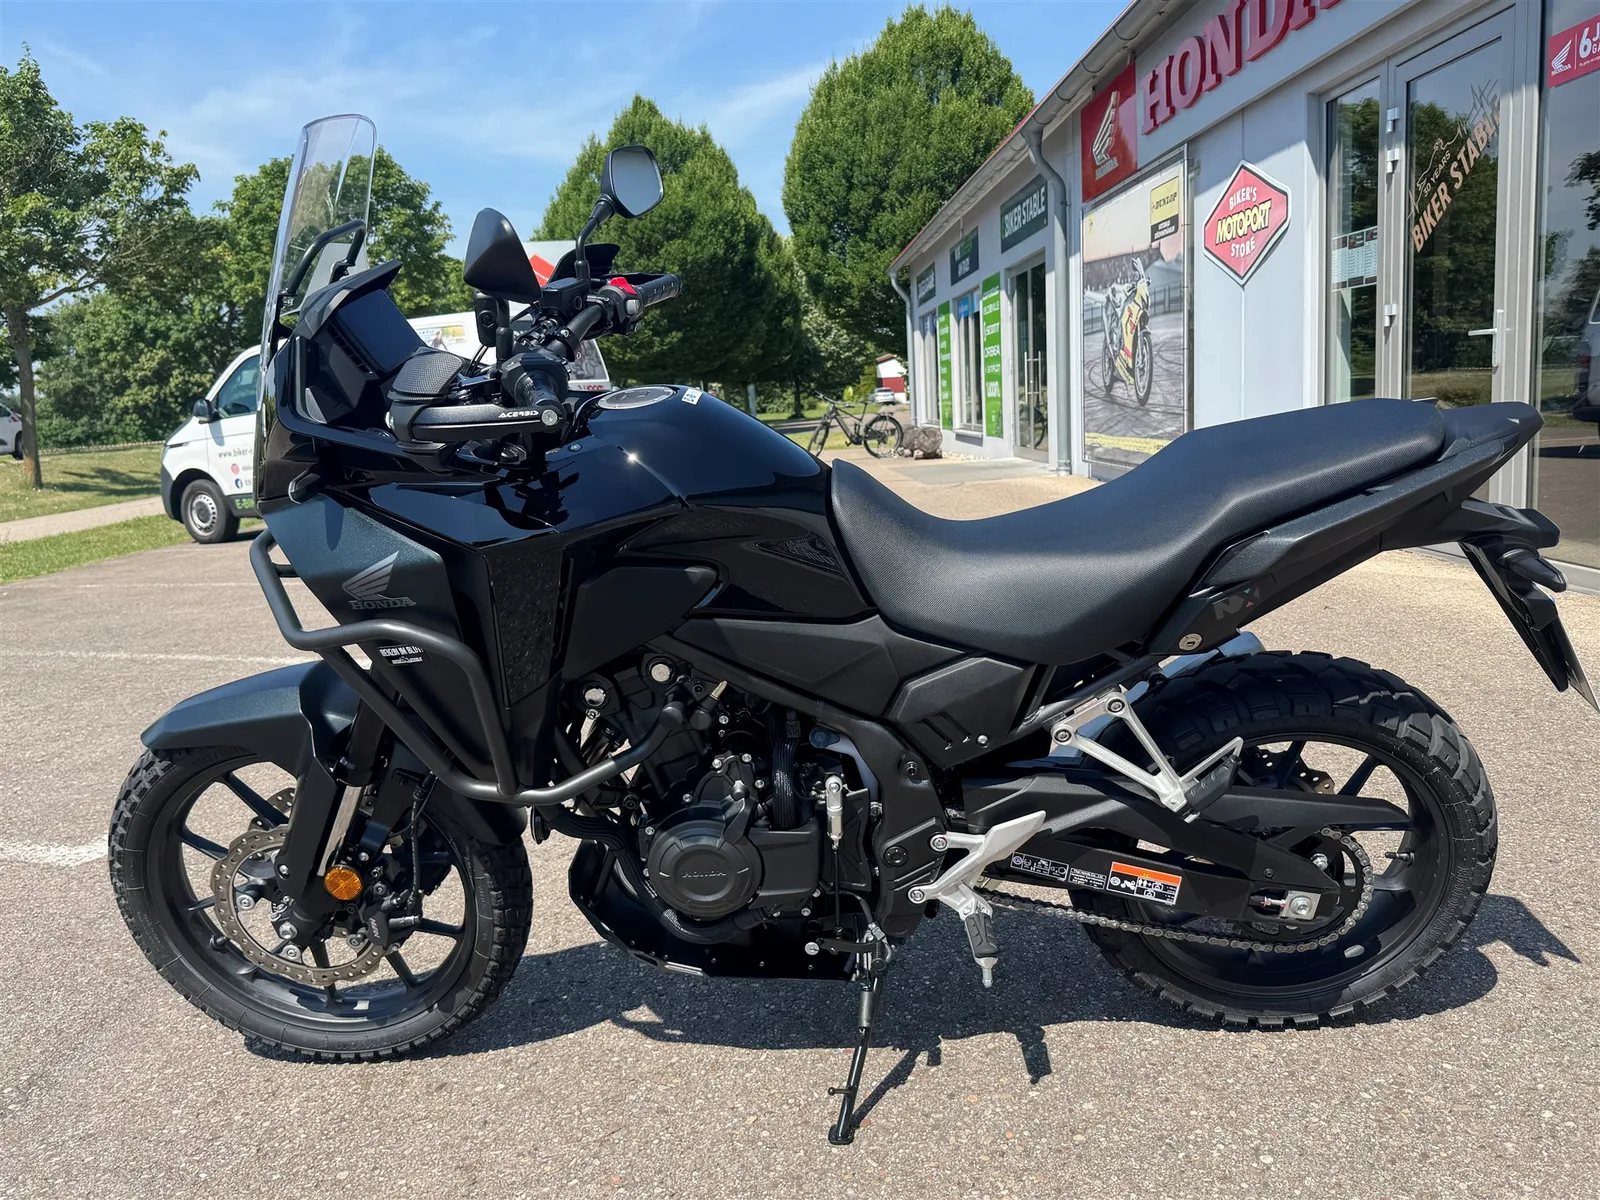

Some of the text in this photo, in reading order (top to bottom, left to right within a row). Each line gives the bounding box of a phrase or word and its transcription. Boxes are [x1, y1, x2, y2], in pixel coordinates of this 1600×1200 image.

[1579, 26, 1592, 59] 6
[1140, 0, 1340, 135] HOND
[1430, 150, 1451, 184] YEARS
[1005, 186, 1046, 238] BIKER STABLE
[1155, 192, 1178, 210] DUNLOP
[1229, 186, 1257, 211] BIKER'S
[1215, 198, 1272, 246] MOTOPORT
[1411, 182, 1452, 253] BIKER
[1230, 235, 1256, 258] STORE
[348, 597, 416, 610] HONDA
